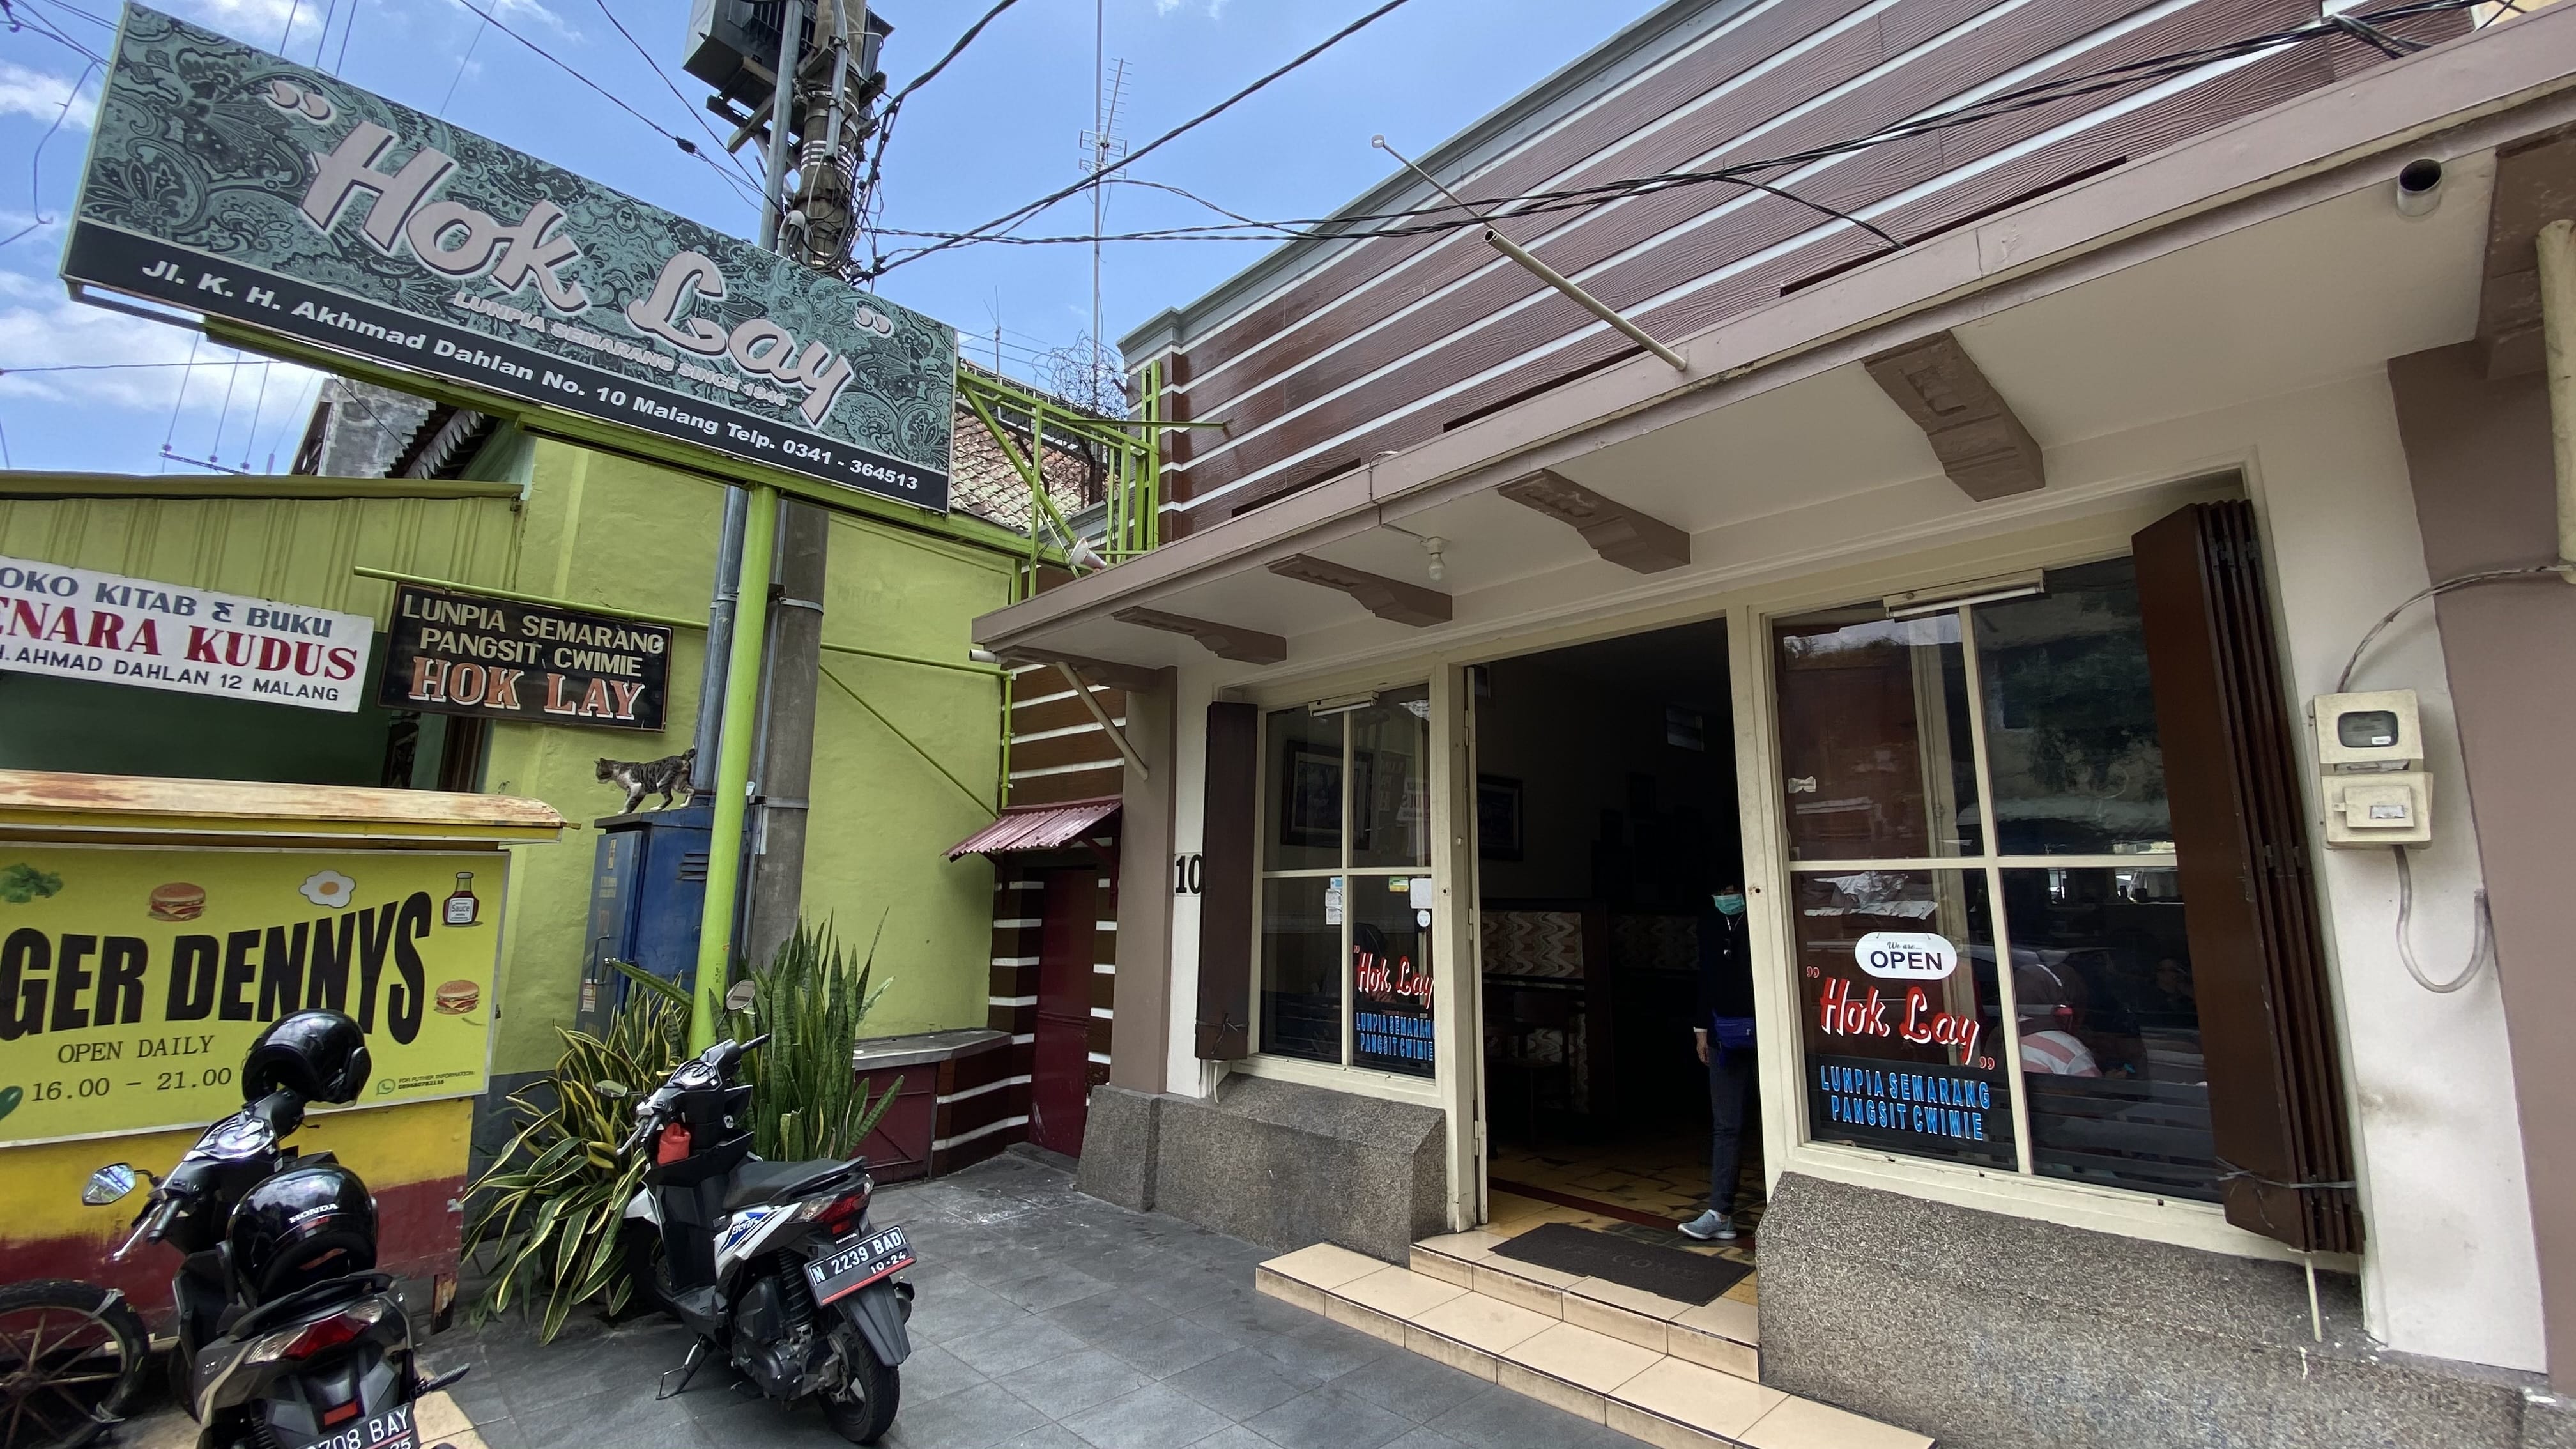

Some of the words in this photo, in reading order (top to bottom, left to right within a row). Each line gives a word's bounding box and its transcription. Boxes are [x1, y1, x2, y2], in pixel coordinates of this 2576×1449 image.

[302, 120, 590, 312] Hok
[627, 252, 854, 428] Lay
[452, 290, 546, 333] LUNPIA
[550, 321, 675, 372] SEMARANG
[678, 362, 740, 396] SINCE
[743, 384, 787, 408] 1946
[142, 260, 183, 285] Jl.
[198, 273, 234, 296] K.
[246, 287, 282, 310] H.
[291, 300, 425, 350] Akhmad
[433, 339, 533, 381] Dahlan
[542, 371, 585, 396] No.
[597, 387, 626, 406] 10
[632, 397, 719, 436] Malang
[726, 423, 776, 451] Telp.
[783, 440, 831, 465] 0341
[850, 460, 919, 491] 364513
[95, 582, 197, 617] KITAB
[247, 607, 332, 638] BUKU
[402, 594, 506, 632] LUNPIA
[522, 615, 664, 654] SEMARANG
[15, 647, 103, 671] AHMAD
[114, 659, 210, 686] DAHLAN
[220, 673, 242, 690] 12
[252, 678, 339, 702] MALANG
[184, 625, 358, 681] KUDUS
[420, 627, 542, 665] PANGSIT
[553, 647, 643, 677] CWIMIE
[408, 656, 525, 710] HOK
[544, 673, 645, 721] LAY
[1175, 854, 1206, 894] 10
[452, 904, 470, 912] Sauce
[165, 891, 433, 1045] DENNYS
[1870, 951, 1942, 970] OPEN
[1887, 941, 1901, 949] We
[1357, 952, 1392, 993] Hok
[1395, 955, 1434, 1009] Lay
[1356, 1012, 1387, 1033] LUNPIA
[1390, 1015, 1435, 1039] SEMARAN
[1820, 977, 1890, 1037] Hok
[1899, 986, 1980, 1066] Lay
[57, 1040, 123, 1064] OPEN
[138, 1034, 216, 1059] DAILY
[1360, 1032, 1397, 1056] PANGSIT
[1400, 1038, 1433, 1061] CWIMIE
[31, 1077, 110, 1101] 16.00
[156, 1067, 232, 1091] 21.00
[1821, 1065, 1884, 1098] LUNPIA
[1889, 1072, 1991, 1110] SEMARANG
[1830, 1094, 1906, 1130] PANGSIT
[1912, 1105, 1984, 1141] CWIMIE
[289, 1203, 339, 1224] HONDA
[811, 1267, 827, 1283] N
[831, 1246, 870, 1275] 2239
[872, 1231, 903, 1255] BAD
[836, 1232, 857, 1245] HONDA
[369, 1406, 409, 1443] BAY
